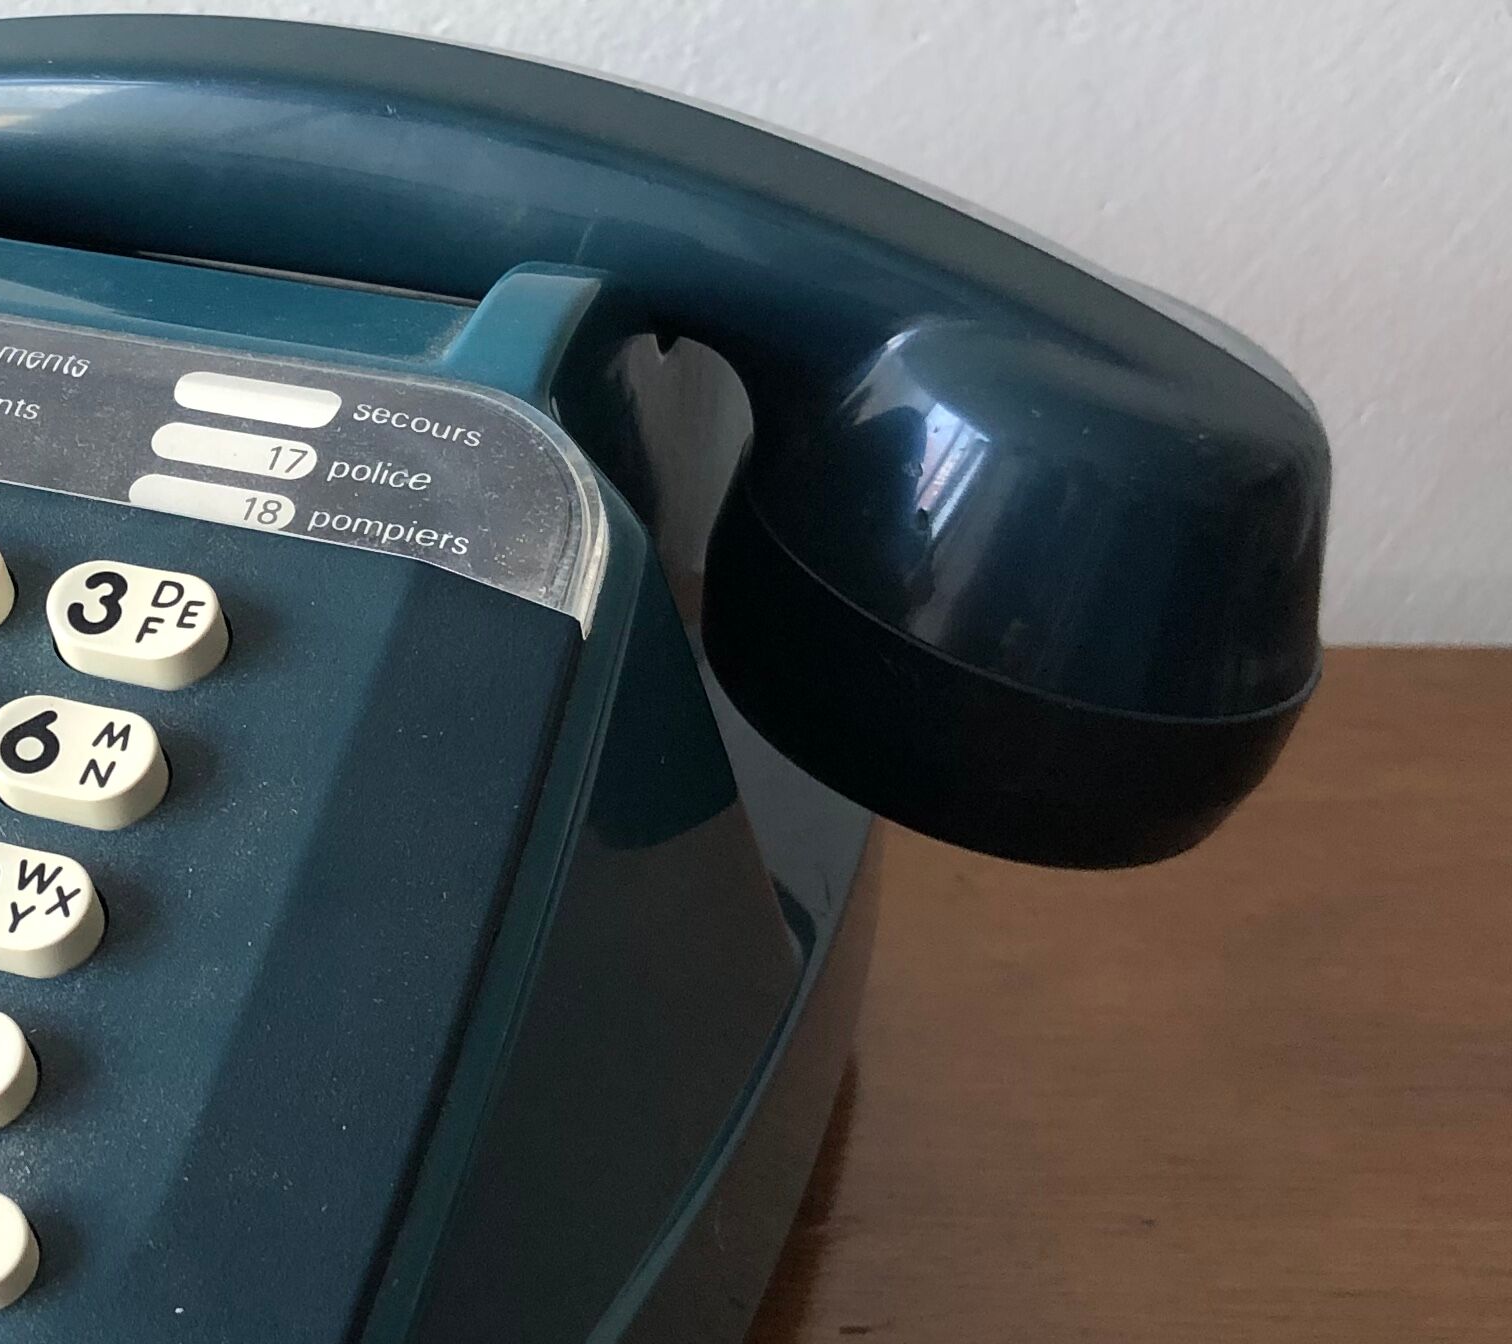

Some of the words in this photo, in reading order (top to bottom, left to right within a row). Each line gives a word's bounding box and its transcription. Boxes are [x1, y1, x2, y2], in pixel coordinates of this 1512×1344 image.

[351, 402, 483, 448] secours
[267, 445, 309, 475] 17
[325, 459, 433, 492] police
[242, 496, 283, 525] 18
[307, 508, 471, 556] pompiers
[68, 572, 127, 634] 3
[0, 711, 59, 773] 6
